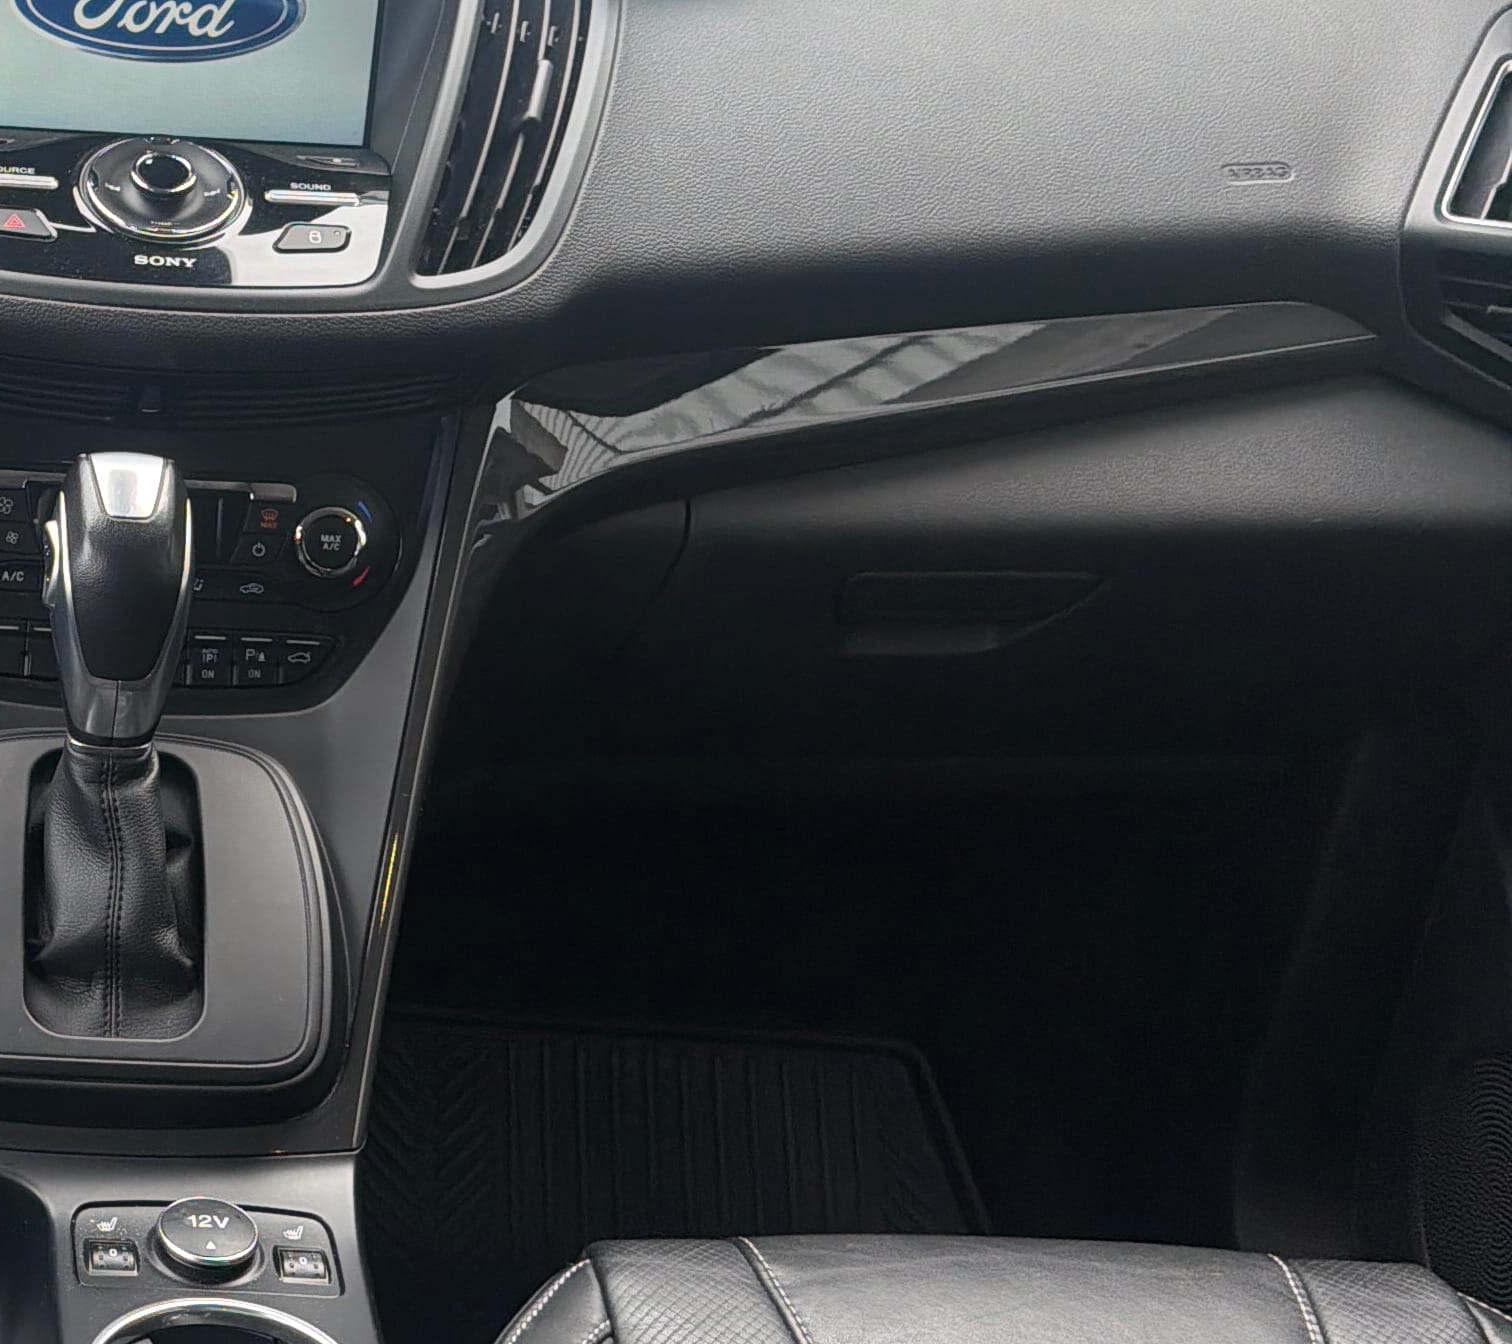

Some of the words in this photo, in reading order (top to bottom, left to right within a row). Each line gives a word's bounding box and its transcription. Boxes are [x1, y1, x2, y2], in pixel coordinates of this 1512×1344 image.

[290, 181, 332, 192] SOUND
[134, 255, 197, 268] SONY
[320, 534, 342, 543] MAX
[322, 543, 341, 552] A/C
[1, 571, 25, 583] A/C
[201, 669, 215, 679] ON
[248, 669, 262, 679] ON
[188, 1214, 230, 1230] 12V
